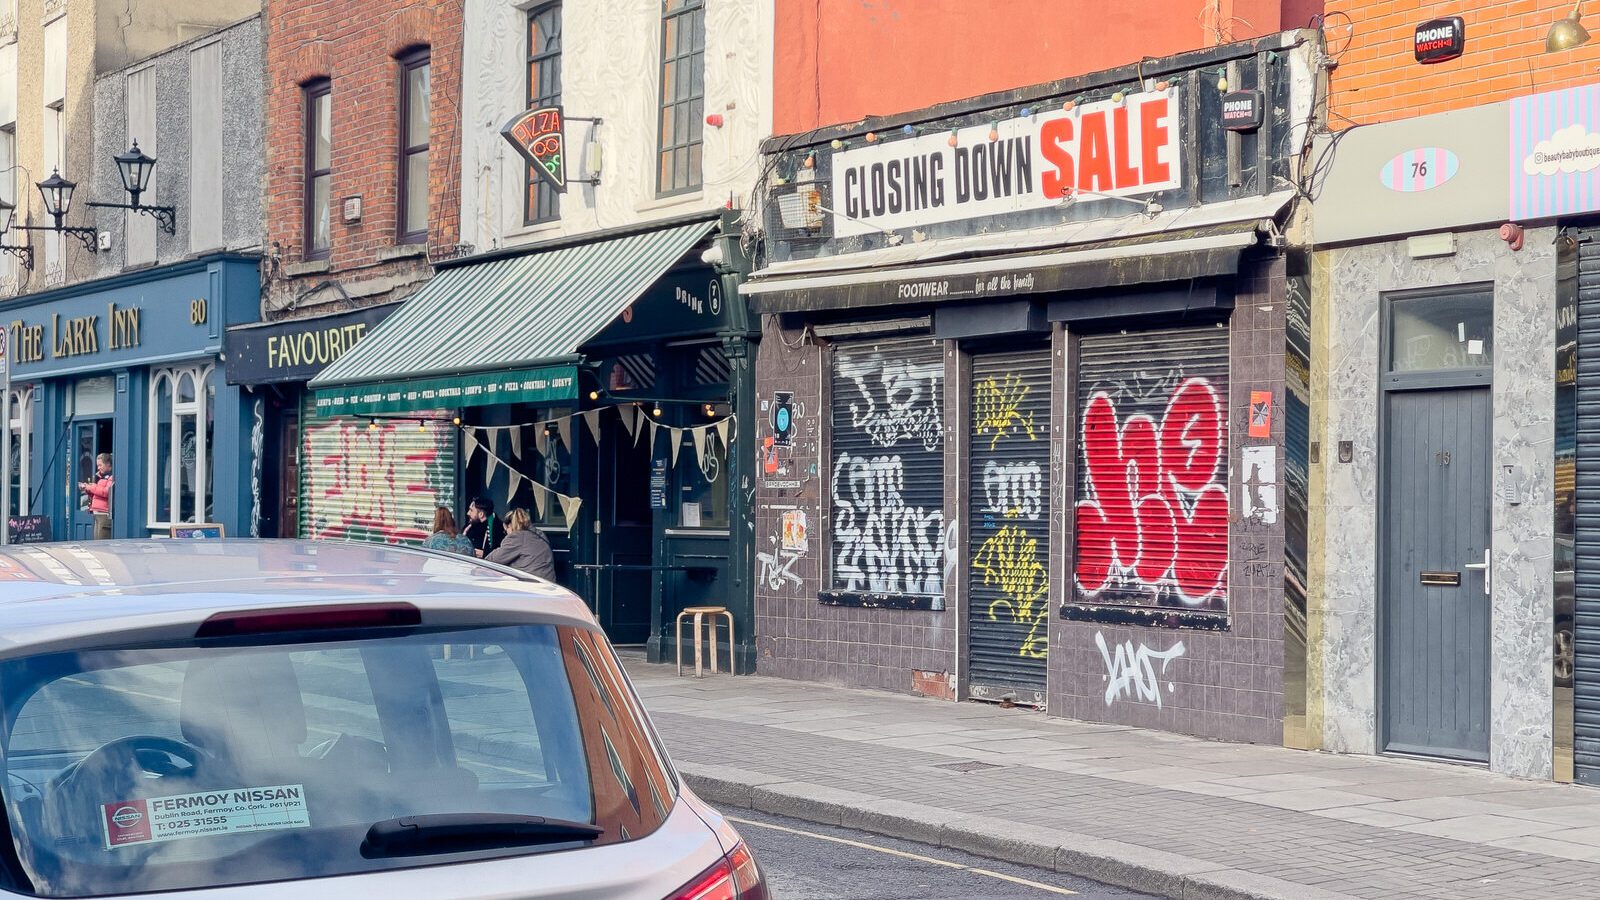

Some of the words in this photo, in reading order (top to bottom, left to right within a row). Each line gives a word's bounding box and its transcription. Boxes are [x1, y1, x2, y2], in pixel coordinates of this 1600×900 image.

[1416, 26, 1453, 44] PHONE
[1416, 40, 1444, 53] WATCH
[1224, 100, 1252, 112] PHONE
[1224, 110, 1245, 119] WATCH
[513, 111, 560, 146] PIZZA
[845, 151, 944, 220] CLOSING
[955, 135, 1034, 204] DOWN
[1041, 98, 1171, 200] SALE
[1411, 161, 1428, 178] 76
[975, 278, 985, 295] for
[987, 276, 999, 291] all
[1001, 274, 1011, 290] the
[1013, 272, 1035, 290] family
[675, 286, 703, 314] DRINK
[190, 298, 208, 325] 80
[11, 319, 45, 363] THE
[52, 312, 99, 358] LARK
[108, 302, 142, 349] INN
[504, 382, 519, 392] PIZZA
[523, 380, 546, 391] COCKTAILS
[552, 377, 572, 388] LUCKY'S
[152, 793, 229, 812] FERMOY
[233, 787, 299, 804] NISSAN
[114, 812, 141, 822] NISSAN
[154, 812, 180, 820] Dublin
[180, 810, 203, 818] Road,
[203, 806, 235, 815] Fermoy,
[247, 803, 268, 811] Cork.
[269, 801, 283, 809] P61
[283, 800, 301, 808] VP21
[155, 822, 166, 831] T:
[168, 820, 191, 829] 025
[193, 815, 228, 827] 31555
[156, 825, 229, 839] www.fermoy.nissan.ie
